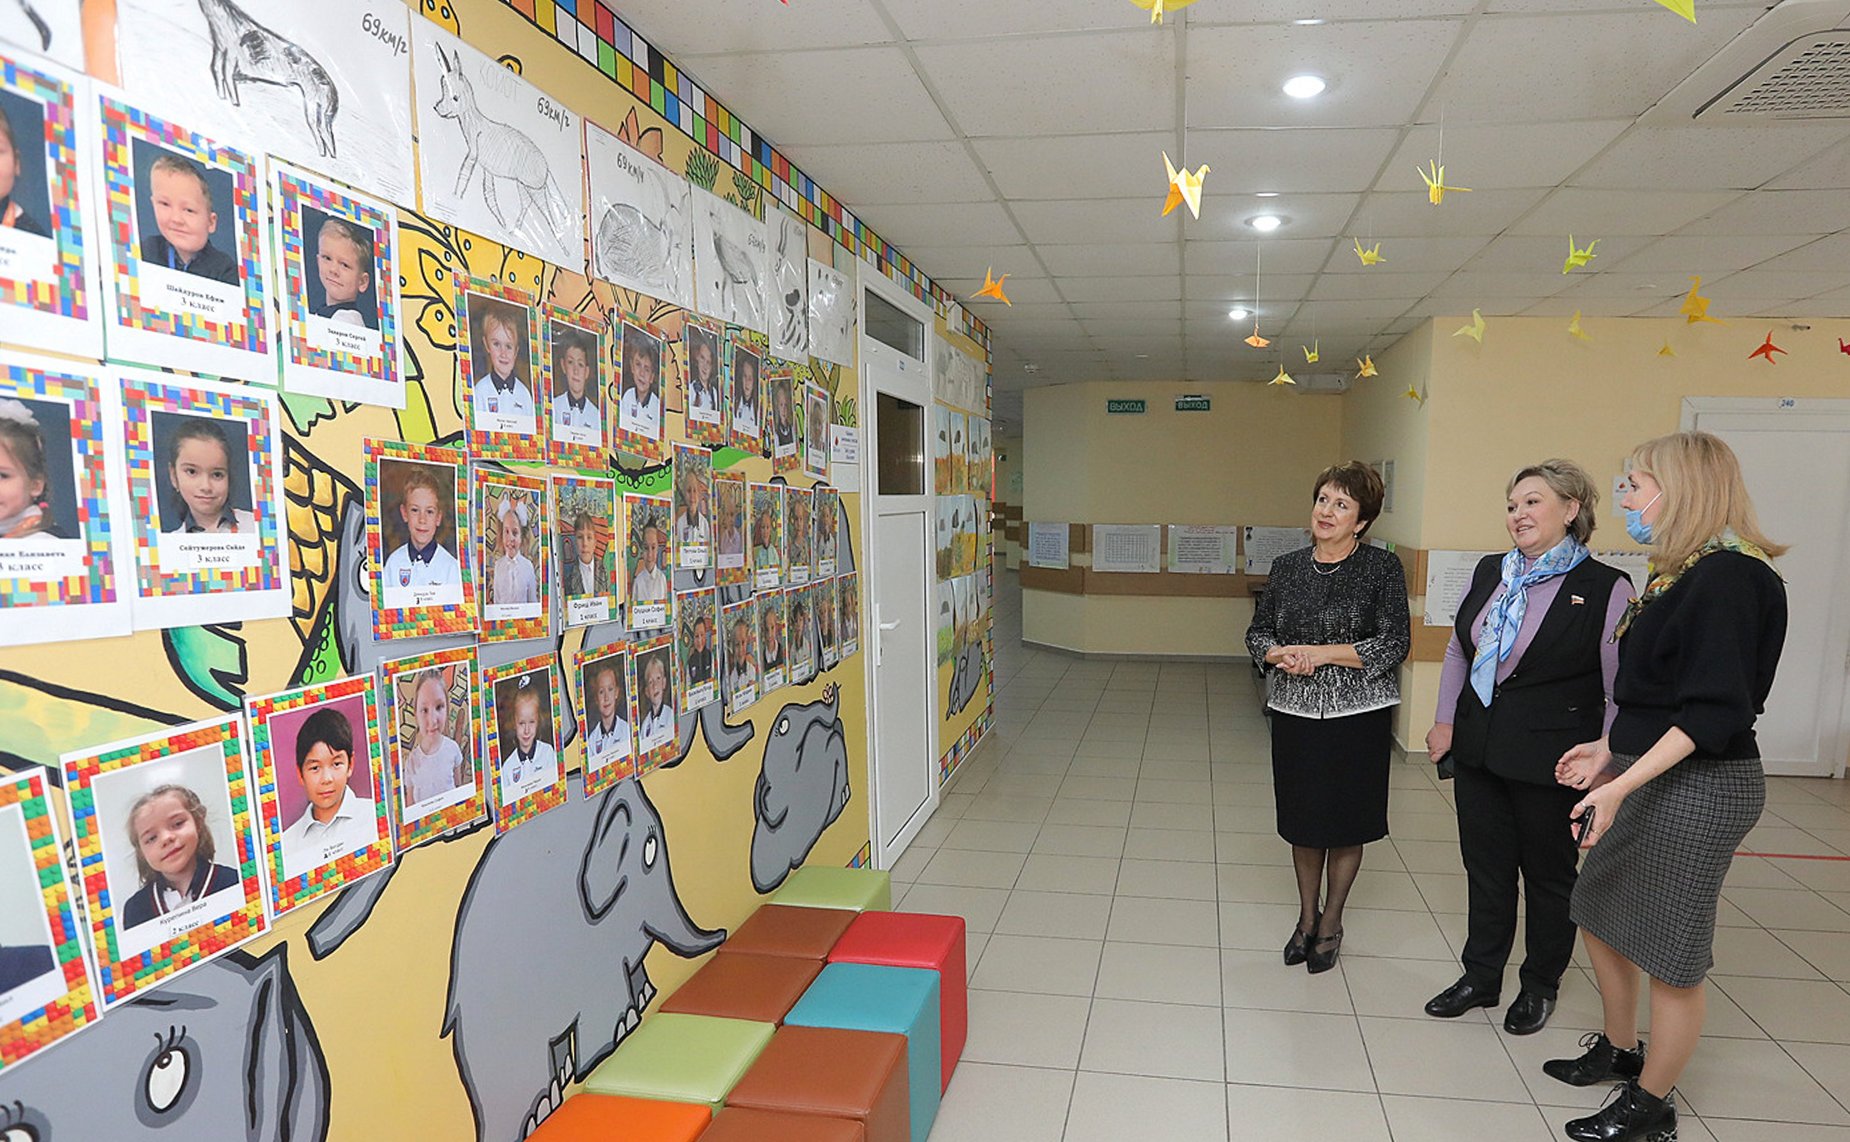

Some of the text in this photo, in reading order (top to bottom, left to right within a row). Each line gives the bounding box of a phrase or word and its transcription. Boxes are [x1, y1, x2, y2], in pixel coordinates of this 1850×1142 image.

[181, 297, 215, 312] 3 класс
[342, 341, 361, 351] класс
[1109, 401, 1144, 411] ВЫХОД
[1177, 401, 1209, 410] ВЫХОД
[197, 554, 202, 563] 3
[178, 920, 200, 932] класс
